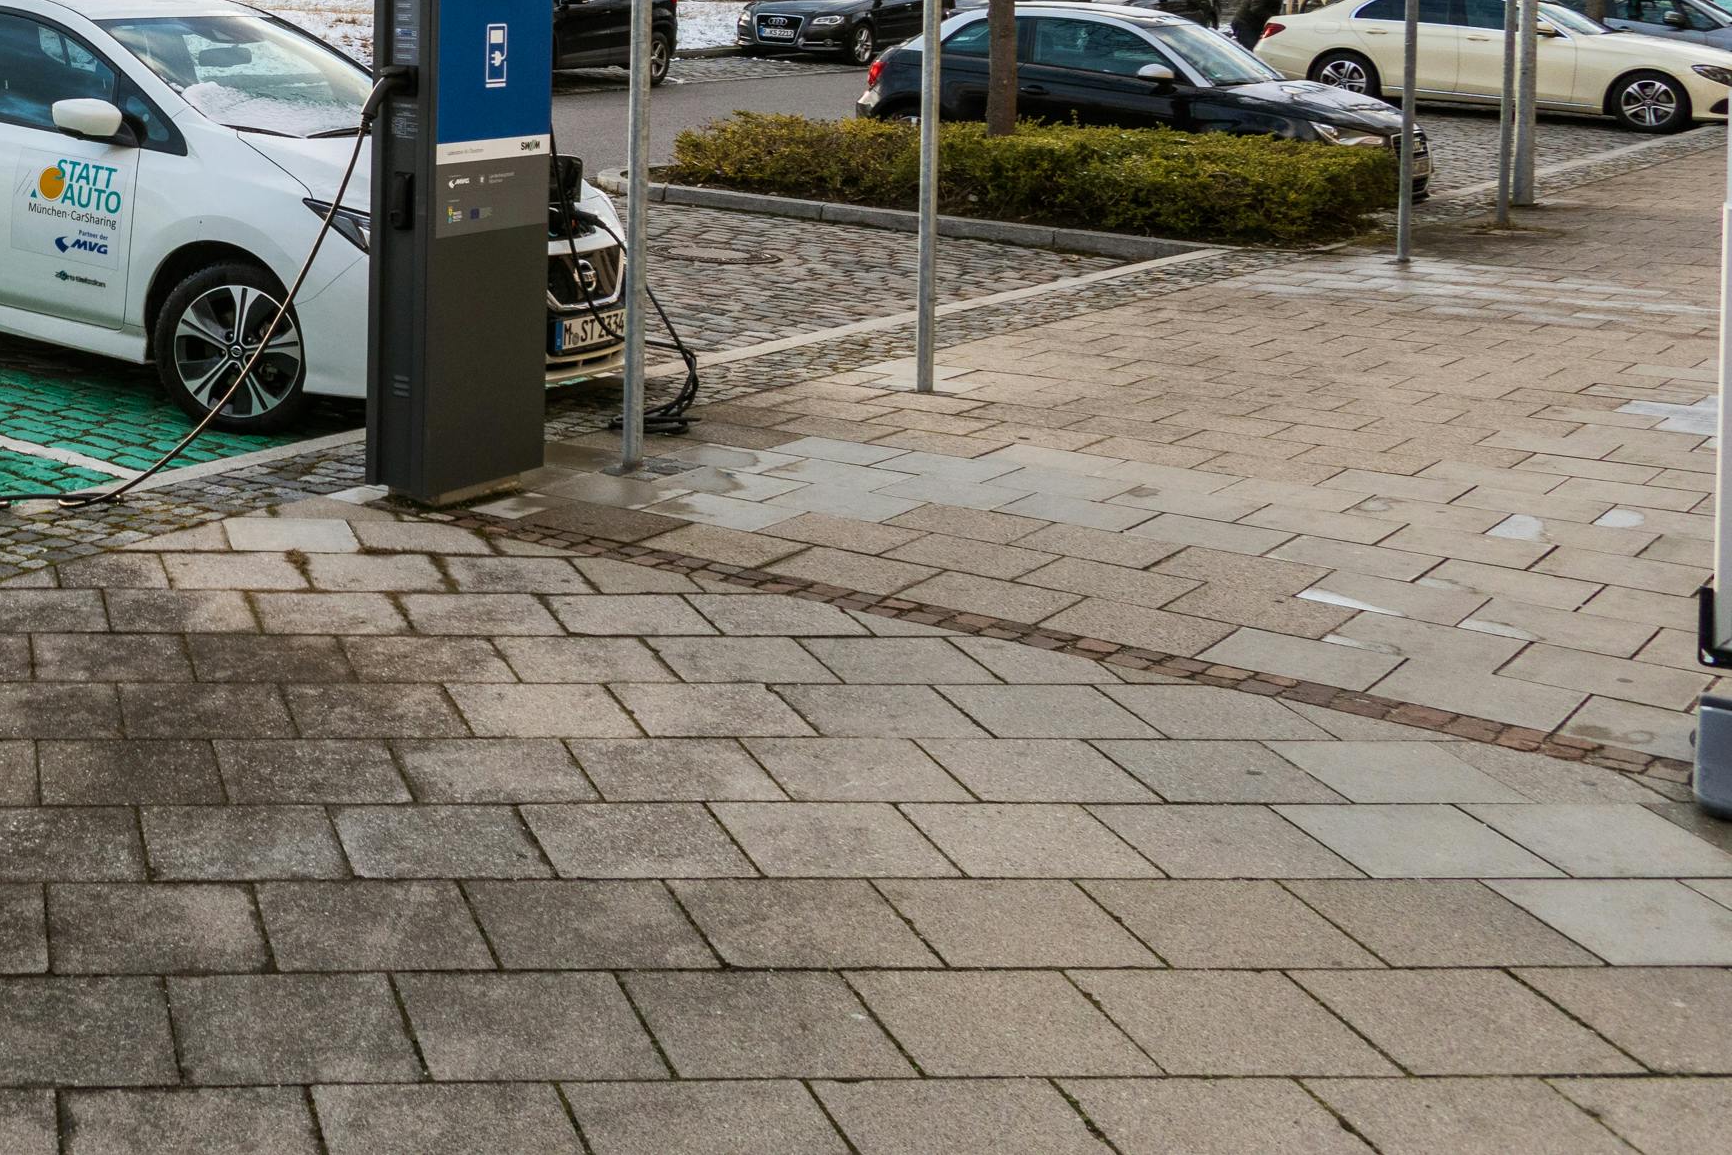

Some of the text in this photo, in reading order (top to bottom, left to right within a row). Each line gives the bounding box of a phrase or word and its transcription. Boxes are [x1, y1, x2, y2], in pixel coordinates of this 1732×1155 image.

[56, 159, 118, 189] STATT
[60, 183, 122, 214] AUTO
[70, 239, 108, 255] MVG
[79, 230, 98, 238] Partner
[564, 323, 572, 346] M
[581, 318, 595, 343] ST
